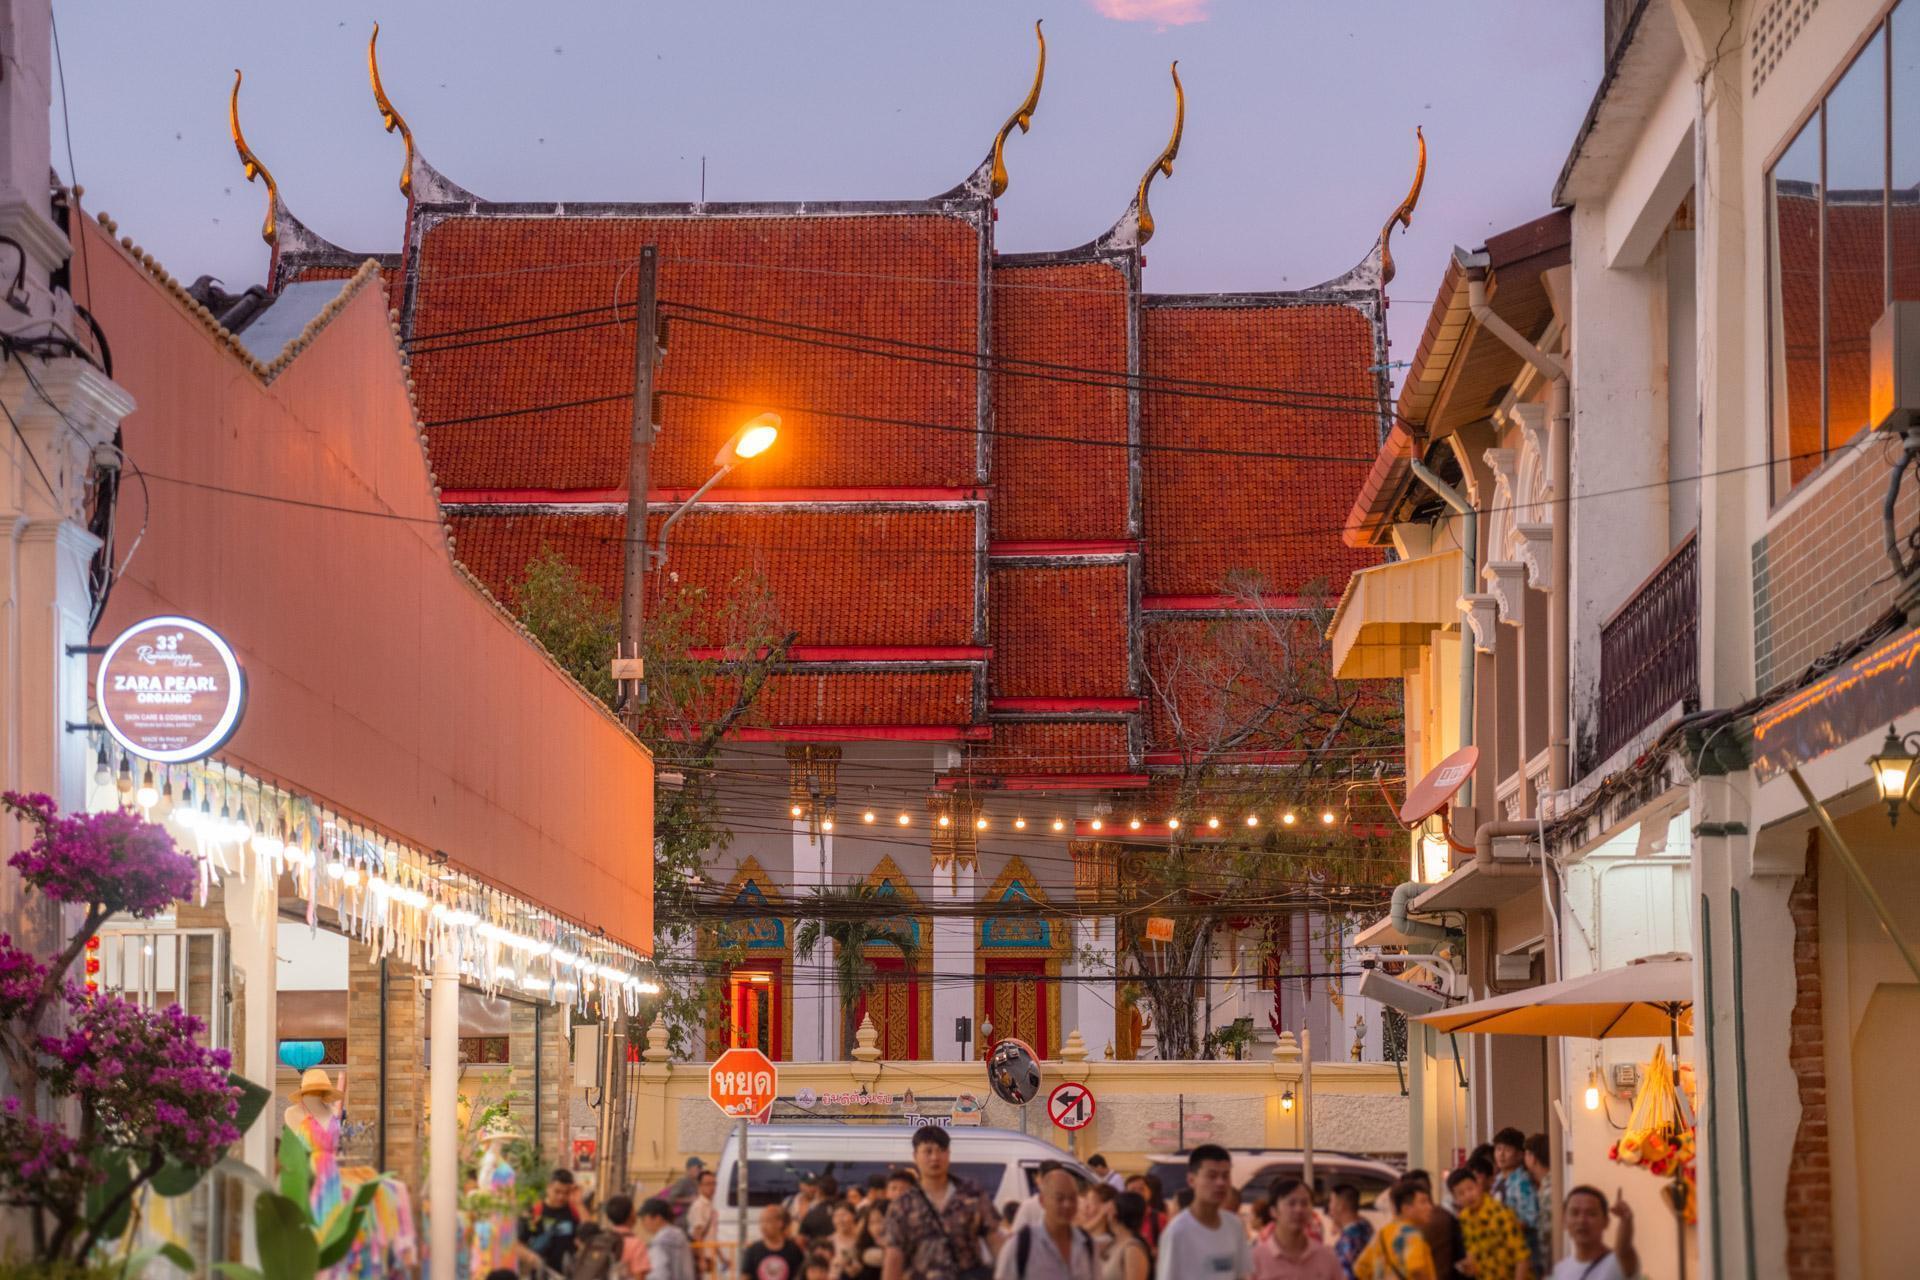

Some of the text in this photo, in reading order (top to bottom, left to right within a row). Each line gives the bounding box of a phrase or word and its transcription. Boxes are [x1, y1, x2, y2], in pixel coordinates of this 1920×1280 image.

[114, 675, 217, 691] ZARA PEARL
[136, 693, 193, 704] ORGANIC
[124, 713, 203, 721] SKIN CARE & COSMETICS
[715, 1071, 771, 1111] หยุด
